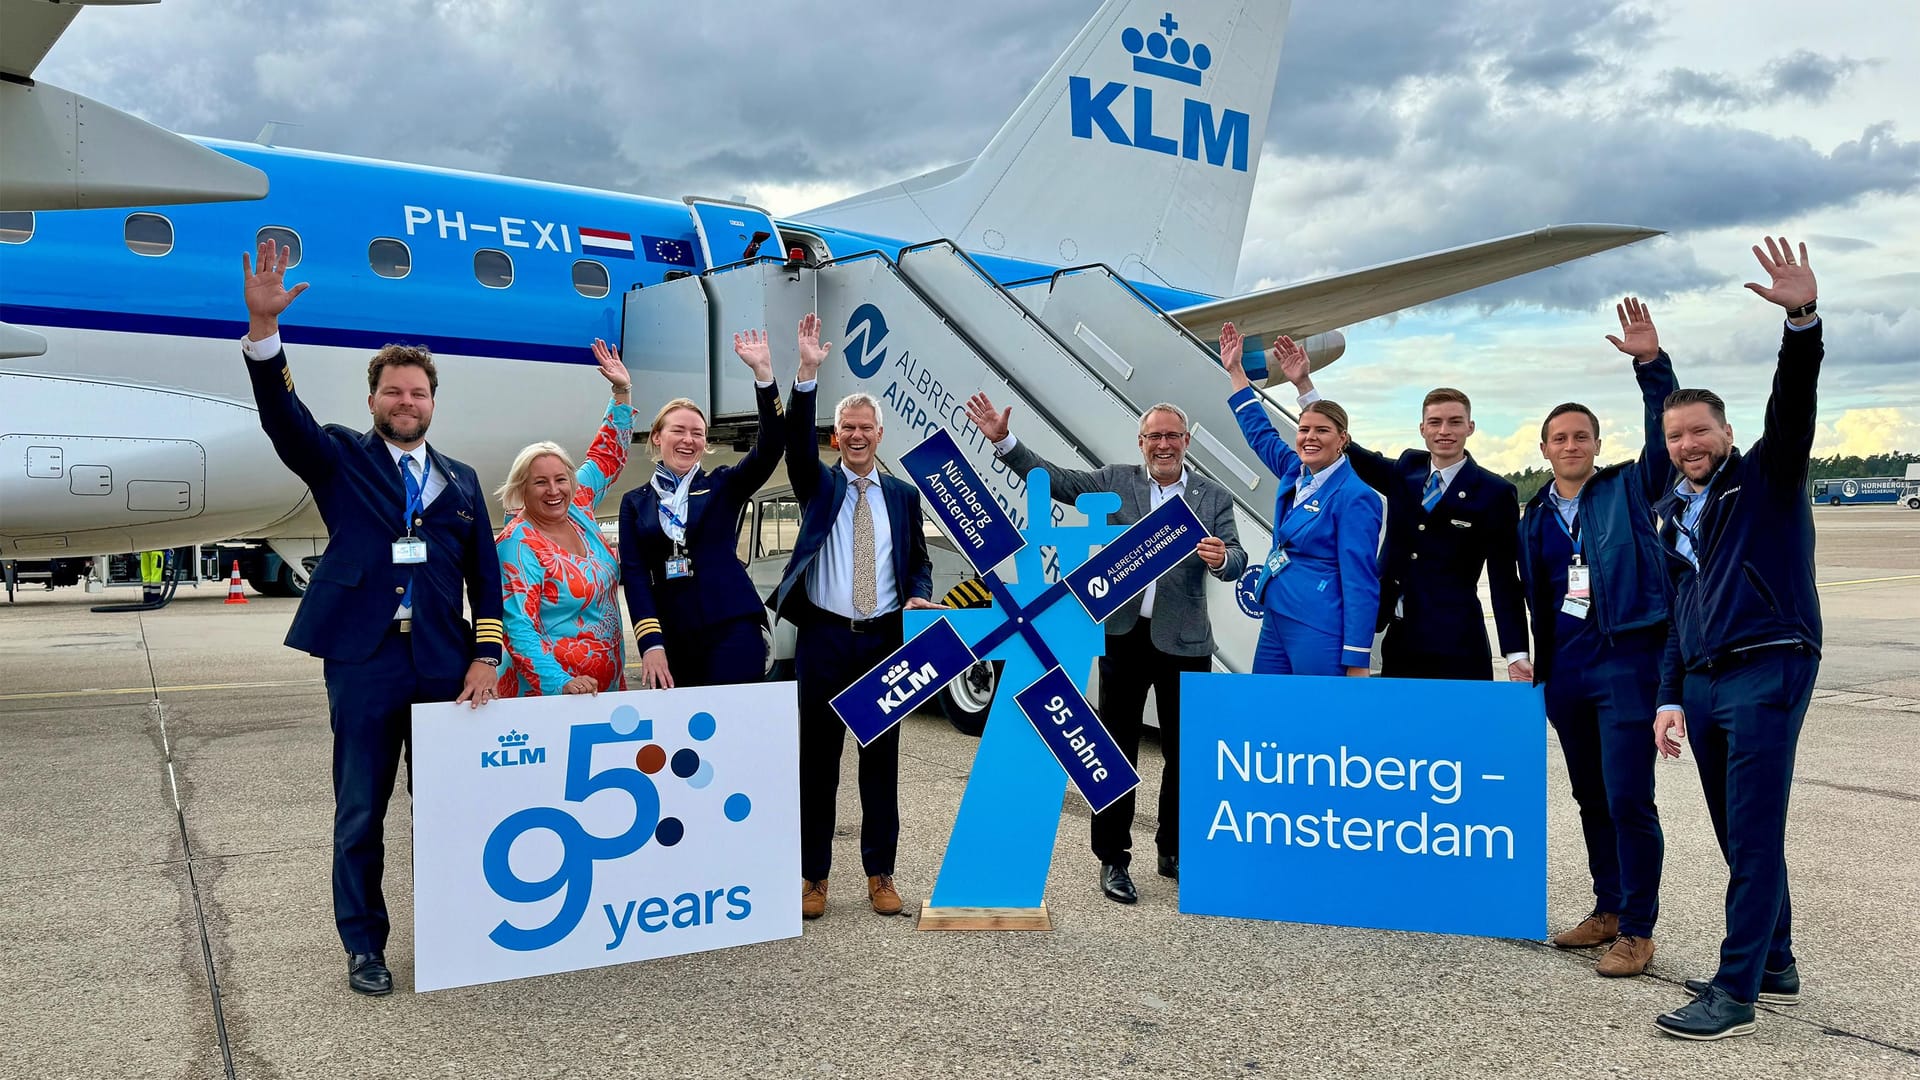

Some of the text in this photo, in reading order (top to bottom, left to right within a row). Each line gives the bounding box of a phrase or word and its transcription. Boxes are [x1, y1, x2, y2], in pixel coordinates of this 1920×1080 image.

[1069, 76, 1250, 172] KLM
[404, 205, 572, 253] PH-EXI
[926, 473, 985, 549] Amsterdam
[941, 460, 992, 529] Nürnberg
[1107, 544, 1145, 577] ALBRECHT
[1112, 556, 1146, 585] AIRPORT
[876, 662, 939, 714] KLM
[481, 747, 546, 768] KLM
[1044, 696, 1108, 783] 95 Jahre
[1217, 740, 1462, 804] Nürnberg
[483, 719, 752, 951] 95 years
[1207, 800, 1514, 859] Amsterdam
